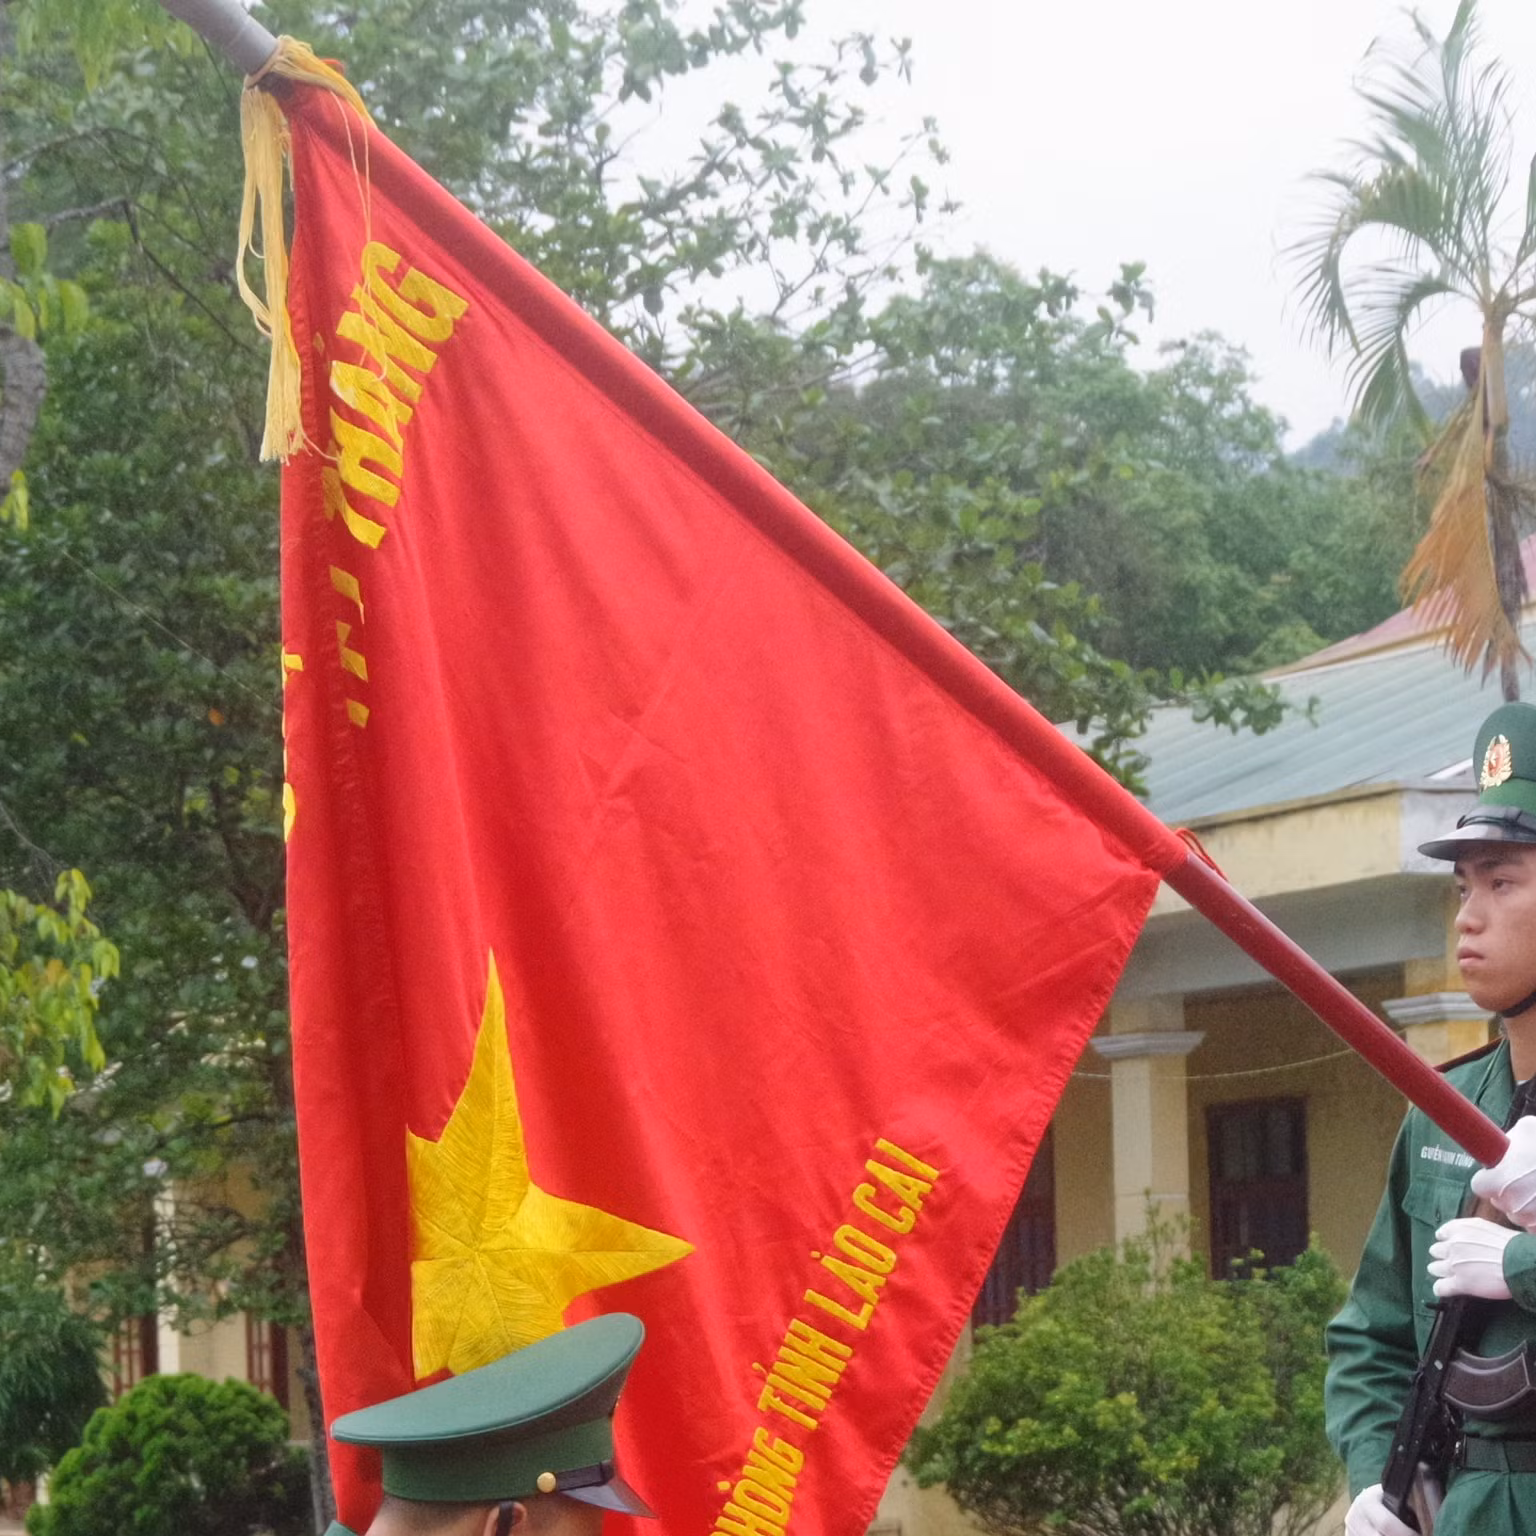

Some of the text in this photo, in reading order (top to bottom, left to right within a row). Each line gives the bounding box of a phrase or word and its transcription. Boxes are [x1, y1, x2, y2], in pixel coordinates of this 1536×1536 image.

[850, 1137, 941, 1234] CAI
[803, 1223, 898, 1330] LÀO
[750, 1318, 854, 1430] TỈNH
